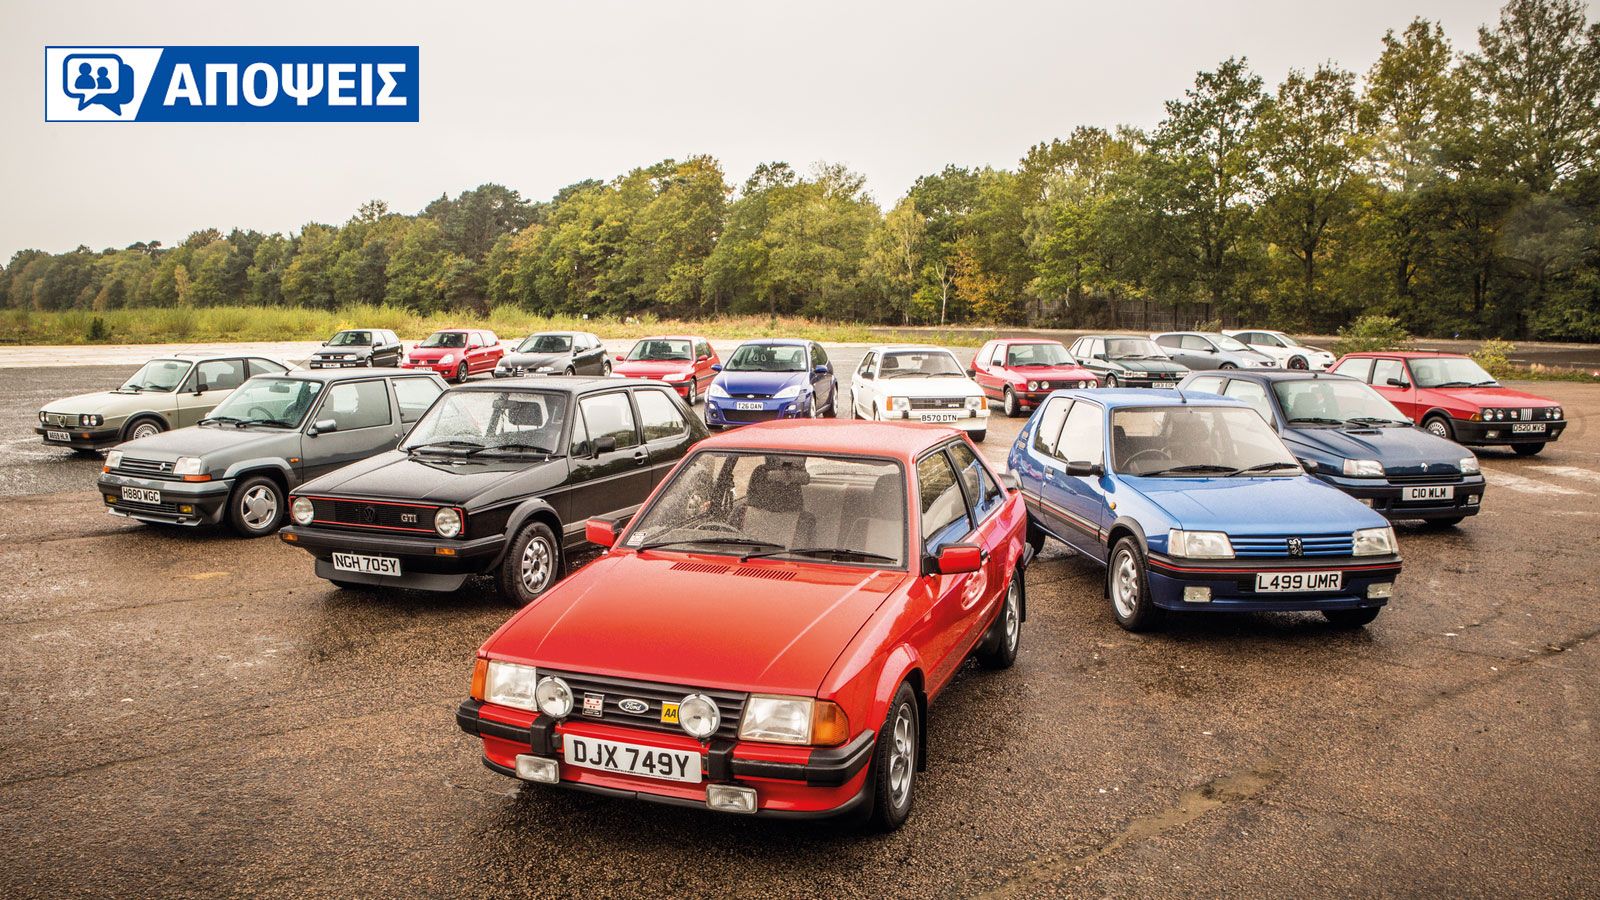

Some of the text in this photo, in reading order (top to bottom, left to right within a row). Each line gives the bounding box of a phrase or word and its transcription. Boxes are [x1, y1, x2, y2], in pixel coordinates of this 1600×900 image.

[123, 487, 160, 502] H880 WGC
[1428, 487, 1446, 498] WLM
[401, 513, 417, 523] GTI
[334, 554, 397, 573] NGH 705Y
[1258, 573, 1339, 590] L499 UMR
[624, 701, 642, 711] Ford
[663, 708, 677, 719] AA
[573, 739, 619, 769] DJX
[625, 747, 690, 778] 749Y
